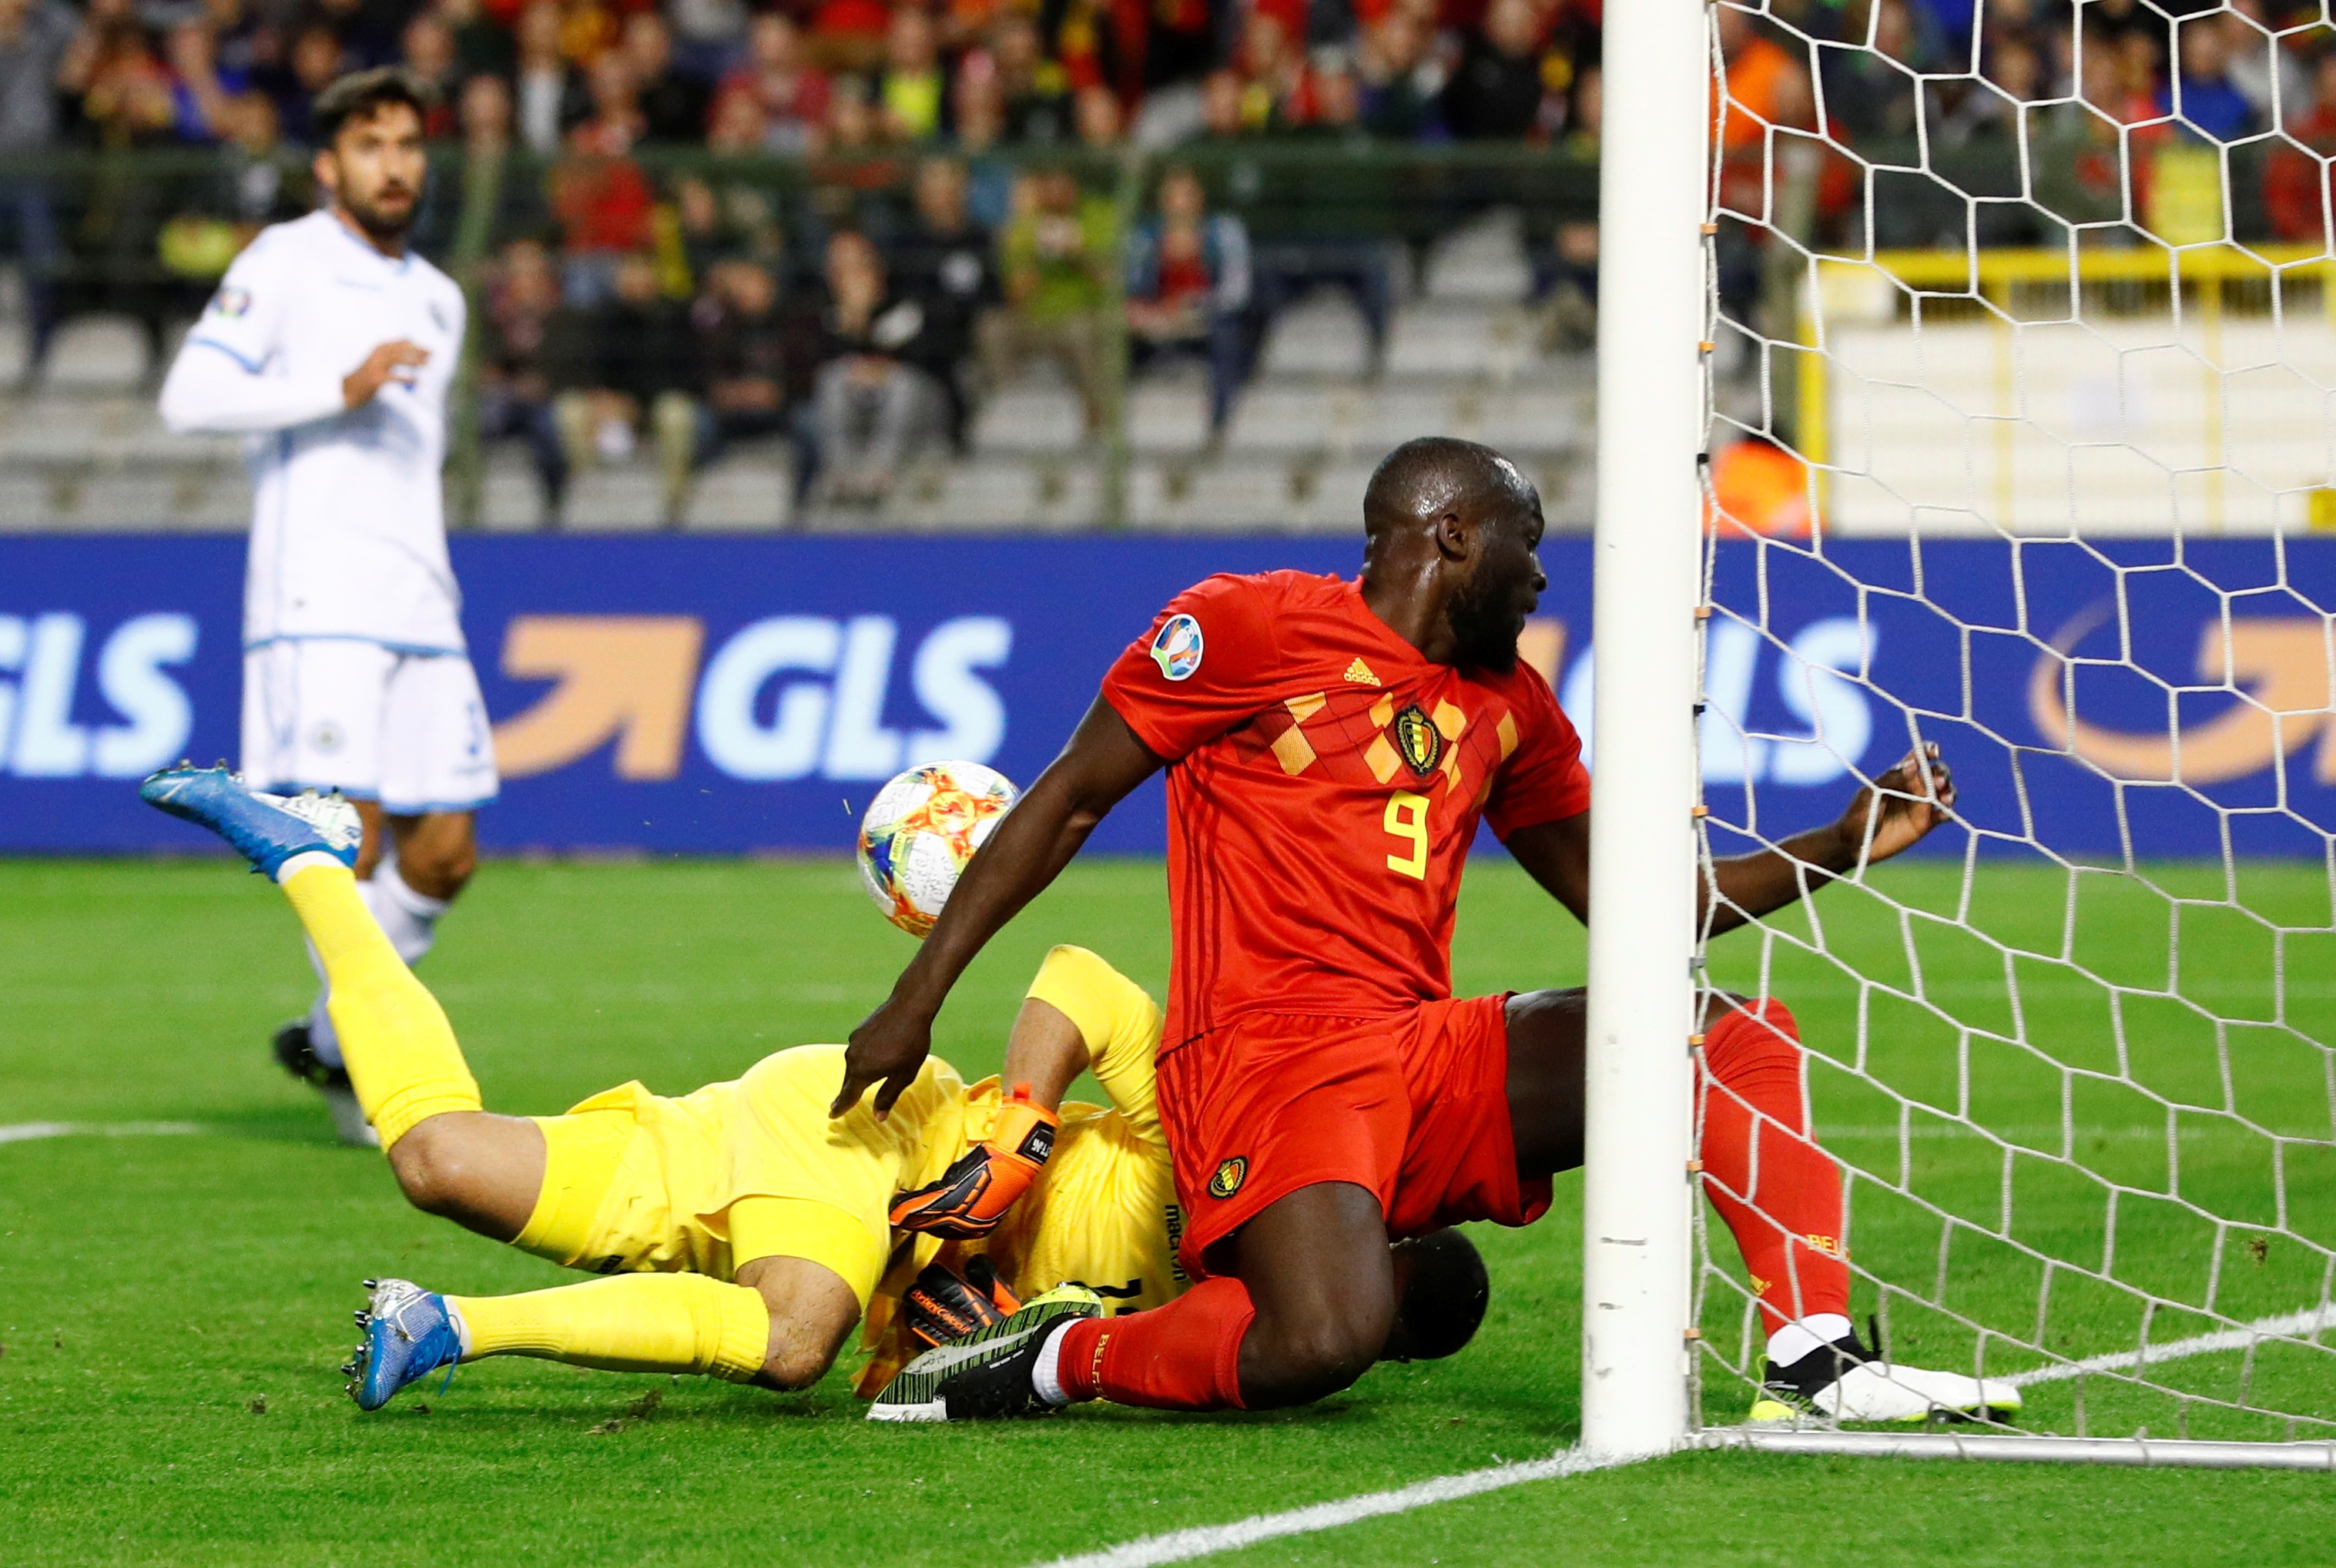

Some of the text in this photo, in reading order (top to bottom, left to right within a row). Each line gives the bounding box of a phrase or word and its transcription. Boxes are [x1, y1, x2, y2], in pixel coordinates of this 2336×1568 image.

[0, 614, 198, 778] LS
[697, 614, 1012, 779] GLS
[1562, 616, 1876, 782] LS
[1384, 790, 1429, 880] 9
